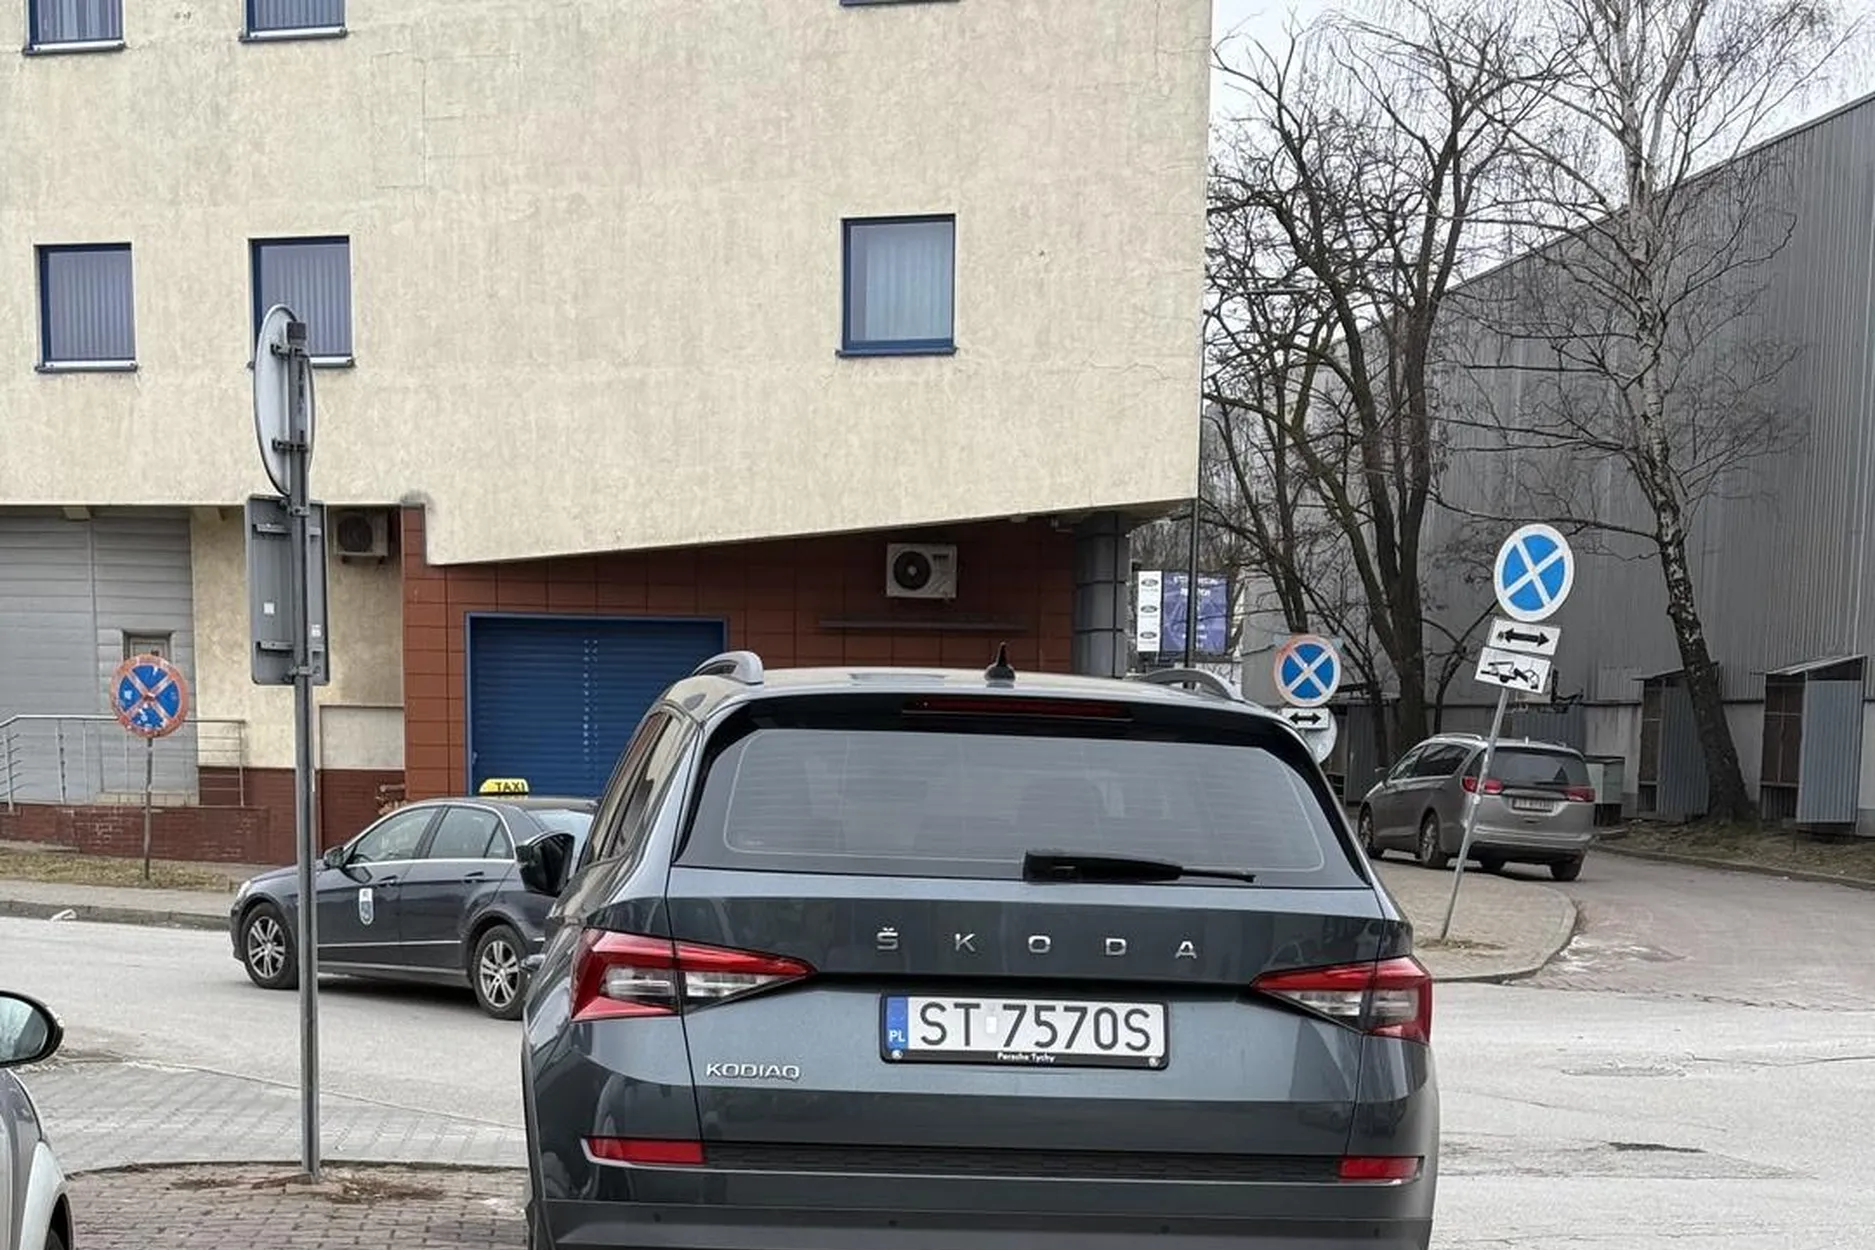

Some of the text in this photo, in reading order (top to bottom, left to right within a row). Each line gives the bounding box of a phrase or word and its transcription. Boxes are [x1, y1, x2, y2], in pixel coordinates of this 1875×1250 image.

[495, 782, 525, 793] TAXI
[876, 927, 1198, 959] ŠKODA
[920, 1001, 1151, 1051] ST 7570S
[889, 1029, 906, 1042] PL
[1032, 1053, 1056, 1063] Tychy
[706, 1063, 800, 1080] KODIAQ
